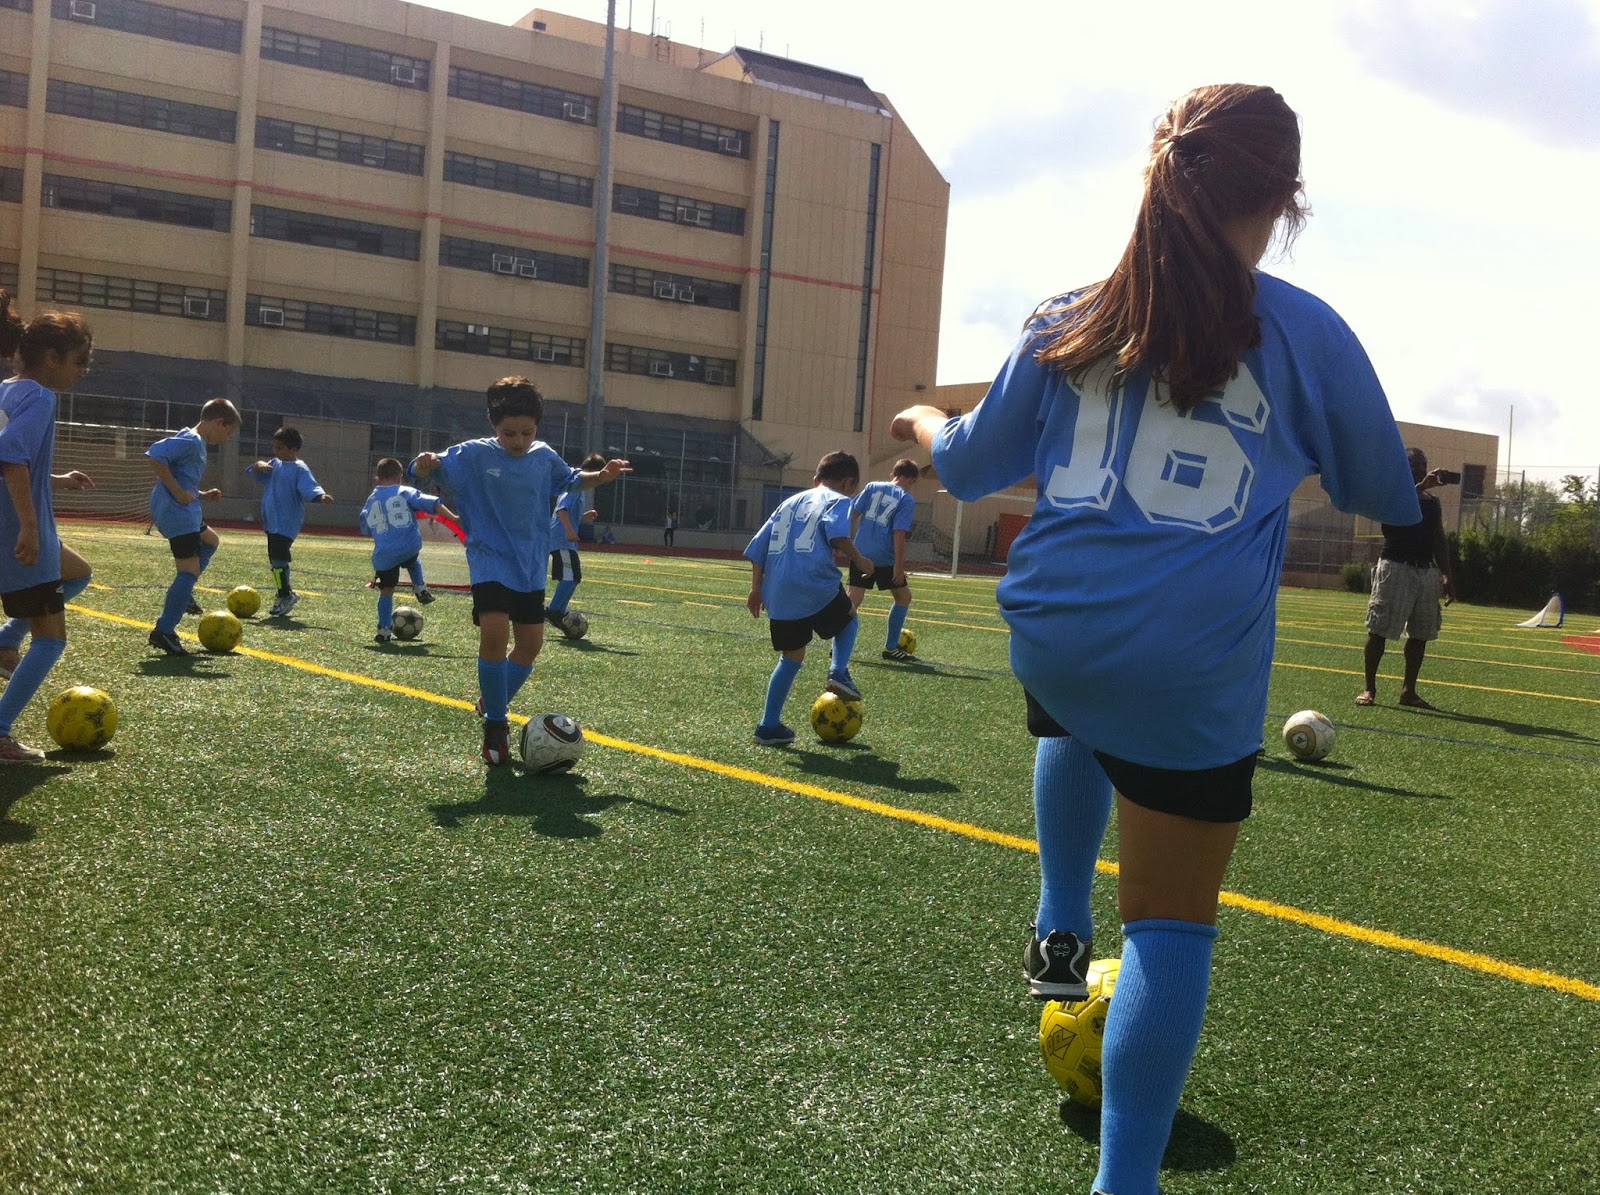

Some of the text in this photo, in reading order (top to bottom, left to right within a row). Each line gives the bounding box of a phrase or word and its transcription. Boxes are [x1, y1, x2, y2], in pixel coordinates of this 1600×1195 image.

[1045, 359, 1270, 534] 16
[366, 494, 413, 534] 48
[865, 491, 900, 527] 17
